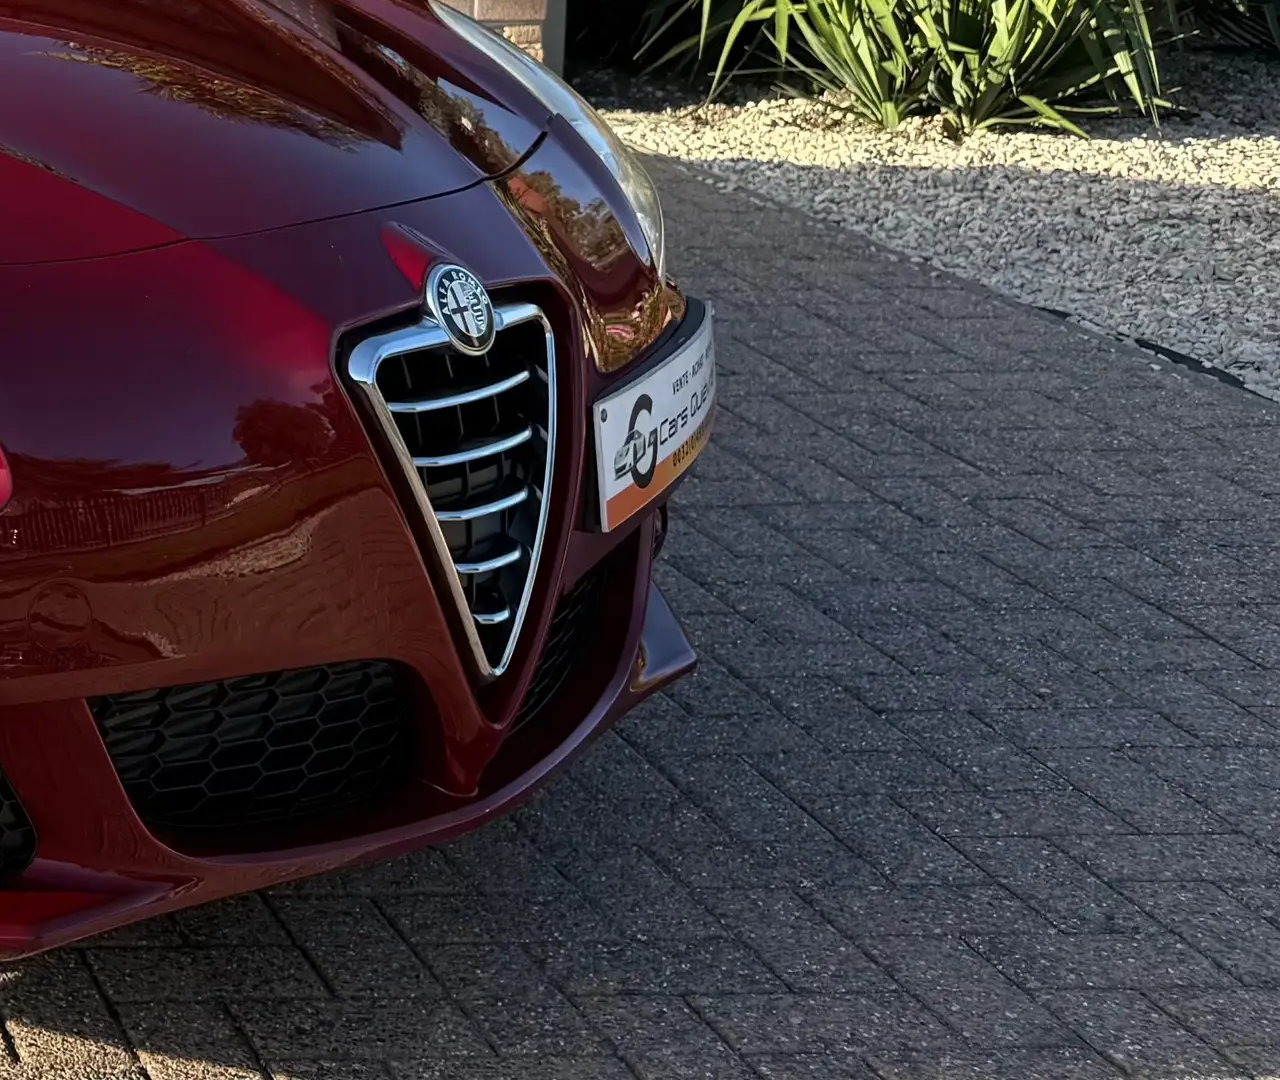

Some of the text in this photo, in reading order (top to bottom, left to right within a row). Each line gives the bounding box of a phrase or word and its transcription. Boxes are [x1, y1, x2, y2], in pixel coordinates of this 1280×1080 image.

[439, 278, 450, 315] ALFA
[672, 370, 689, 395] VENTE
[659, 406, 688, 446] Cars
